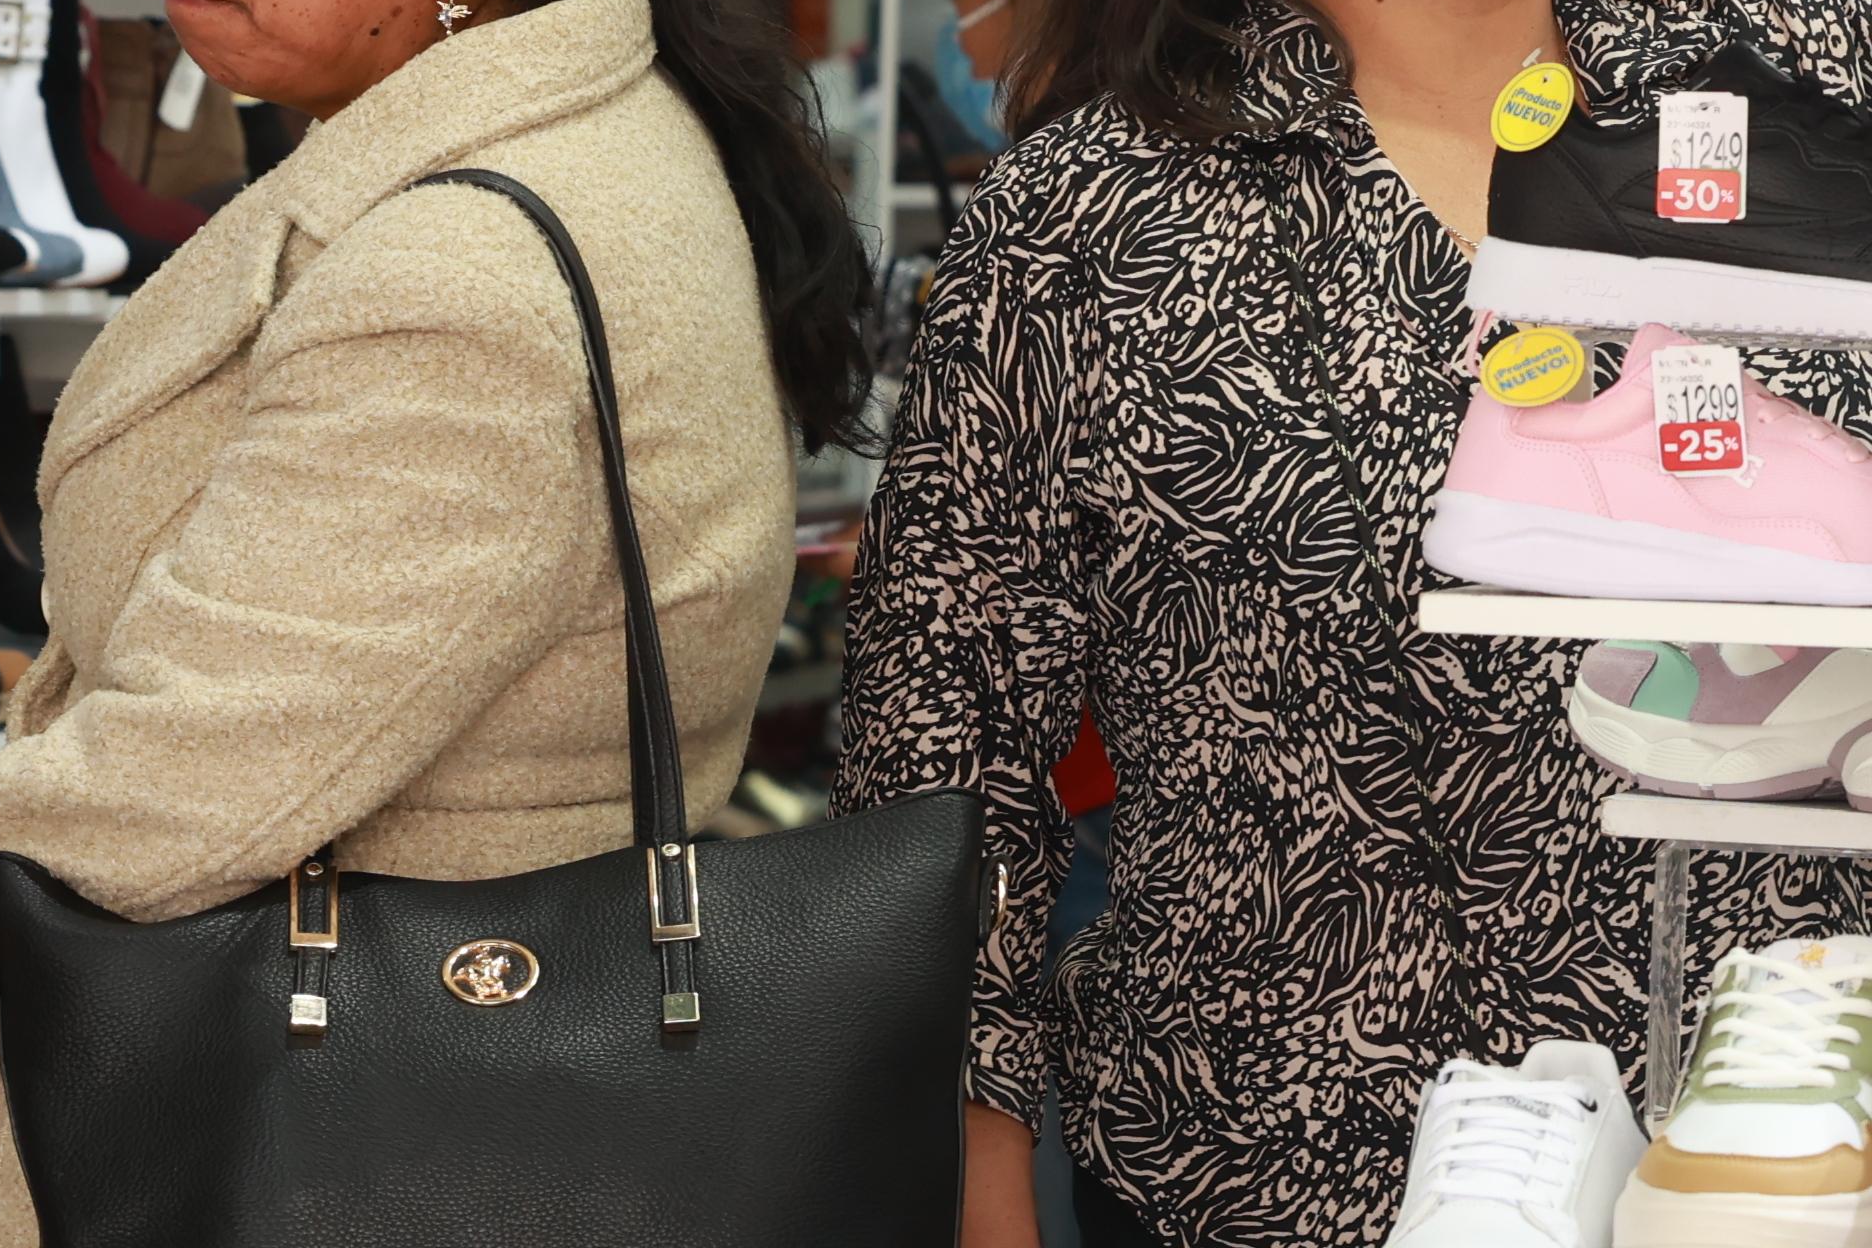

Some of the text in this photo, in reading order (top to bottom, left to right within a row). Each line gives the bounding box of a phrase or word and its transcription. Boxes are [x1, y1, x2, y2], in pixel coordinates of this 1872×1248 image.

[1503, 100, 1557, 127] NUEVO!
[1670, 131, 1743, 170] $1249
[1660, 178, 1735, 213] -30%
[1498, 353, 1570, 391] NUEVO!
[1666, 383, 1739, 424] $1299
[1663, 427, 1740, 462] -25%
